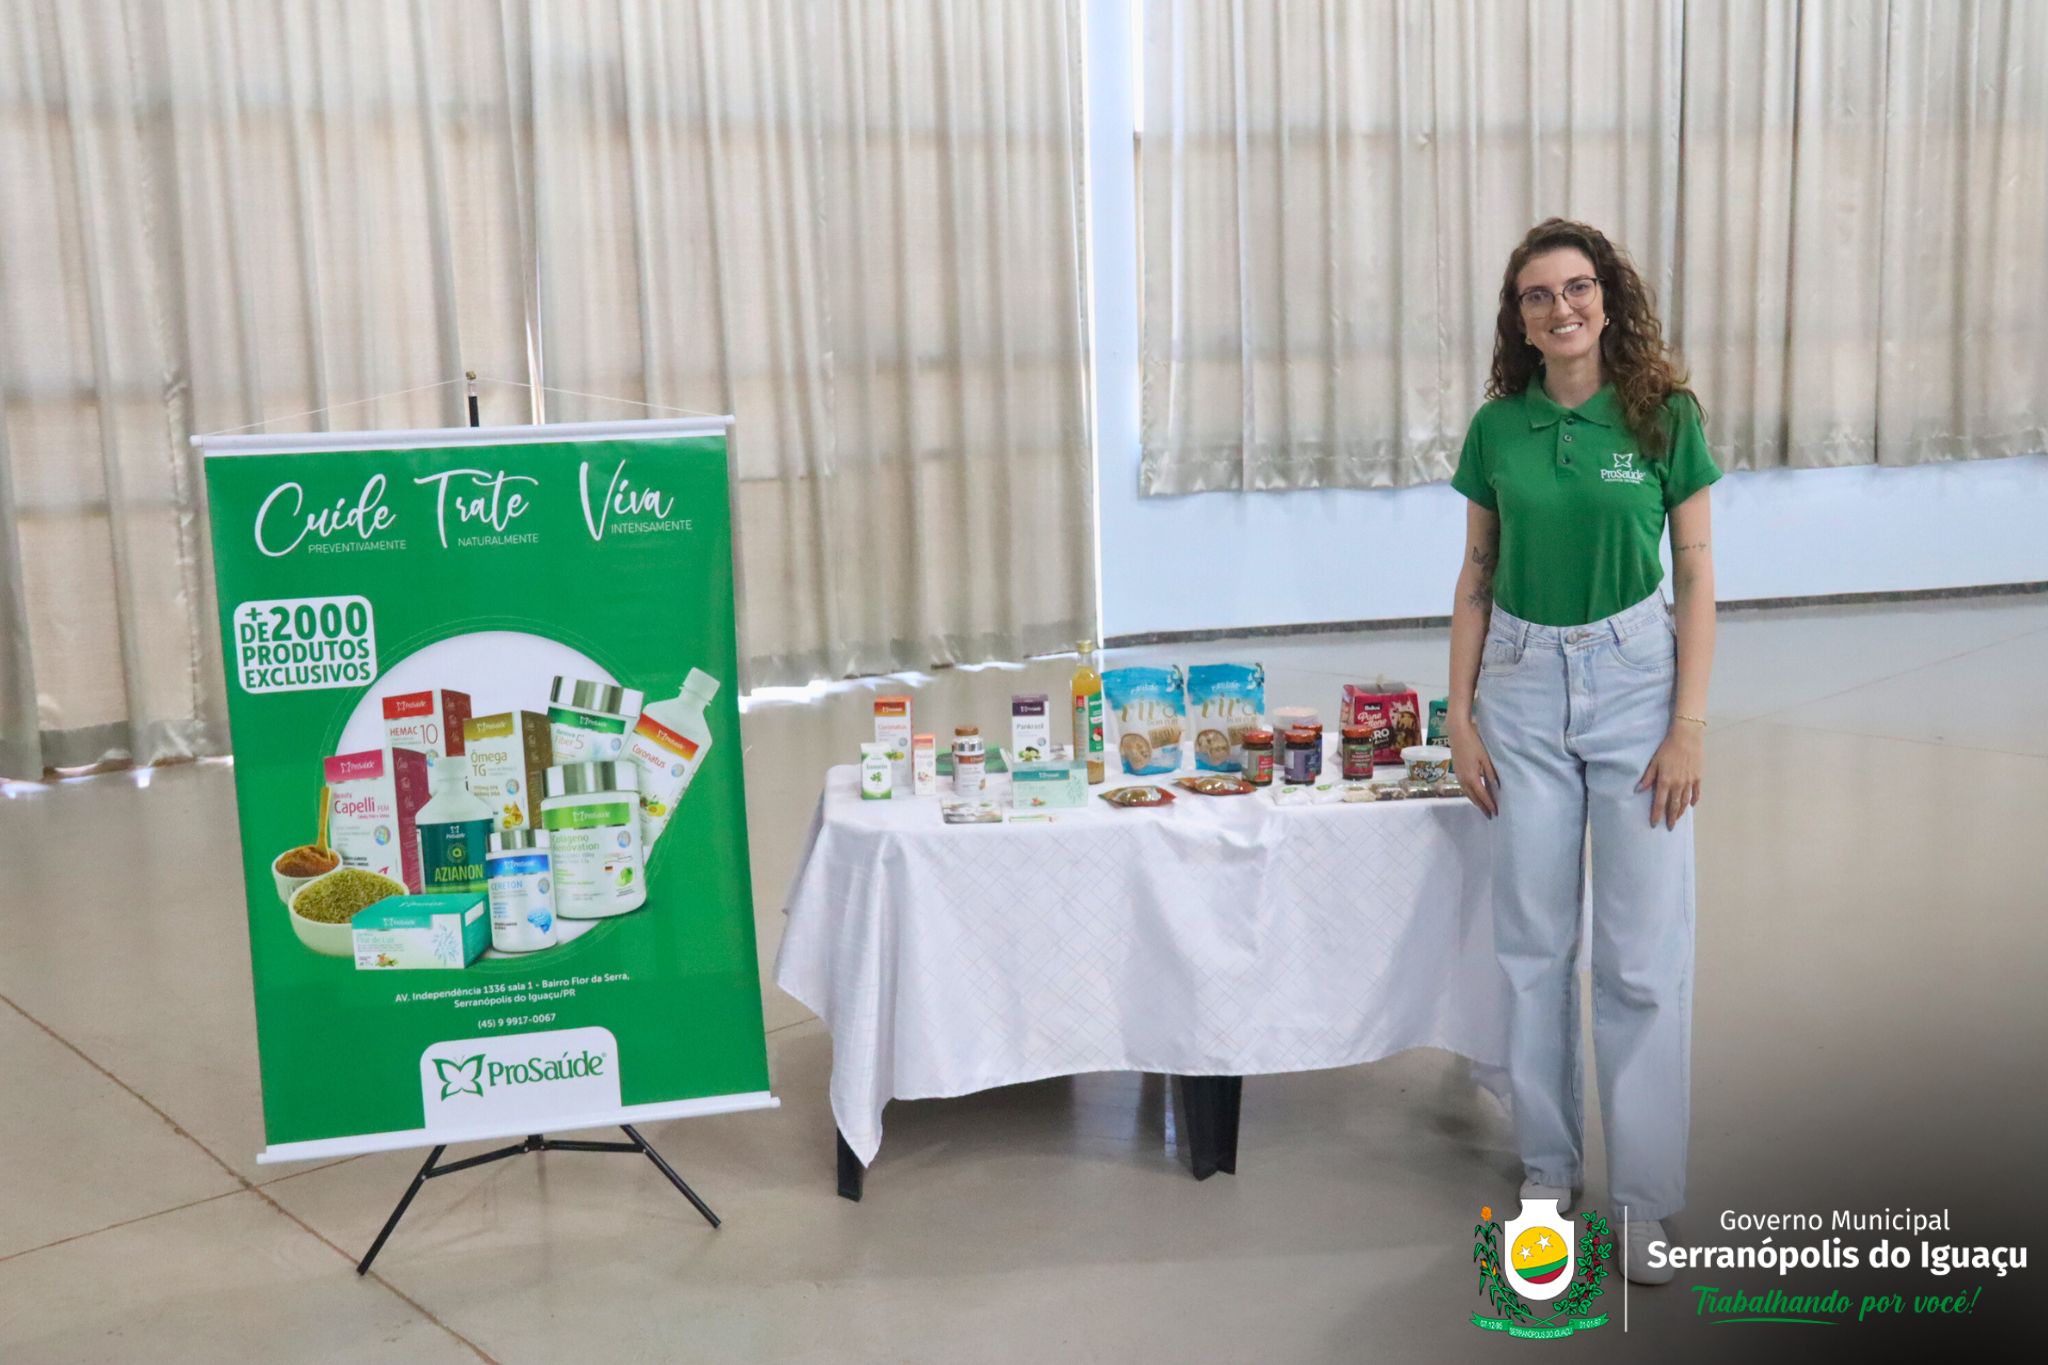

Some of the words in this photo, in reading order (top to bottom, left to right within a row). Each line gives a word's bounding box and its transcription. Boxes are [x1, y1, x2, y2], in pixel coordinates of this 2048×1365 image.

[413, 468, 539, 549] Trate
[610, 519, 693, 534] INTENSAMENTE
[308, 539, 407, 555] PREVENTIVAMENTE
[457, 533, 540, 547] NATURALMENTE
[240, 622, 270, 644] DE
[269, 601, 368, 642] 2000
[242, 638, 370, 667] PRODUTOS
[245, 661, 371, 688] EXCLUSIVOS
[389, 726, 418, 736] HEMAC
[420, 723, 439, 744] 10
[632, 743, 666, 769] Coronatus
[472, 764, 487, 776] TG
[334, 796, 375, 816] Capelli
[434, 864, 484, 882] AZIANON
[395, 993, 410, 1002] AV.
[412, 986, 482, 1000] Independência
[483, 983, 506, 994] 1336
[508, 982, 526, 992] sala
[527, 981, 533, 989] 1
[542, 979, 570, 988] Bairro
[571, 976, 589, 985] Flor
[591, 974, 602, 983] da
[603, 972, 630, 983] Serra,
[454, 995, 512, 1008] Serranópolis
[514, 994, 527, 1003] do
[528, 988, 576, 1003] Iguaçu/PR
[478, 1019, 496, 1029] (45)
[498, 1018, 504, 1027] 9
[506, 1013, 557, 1026] 9917-0067
